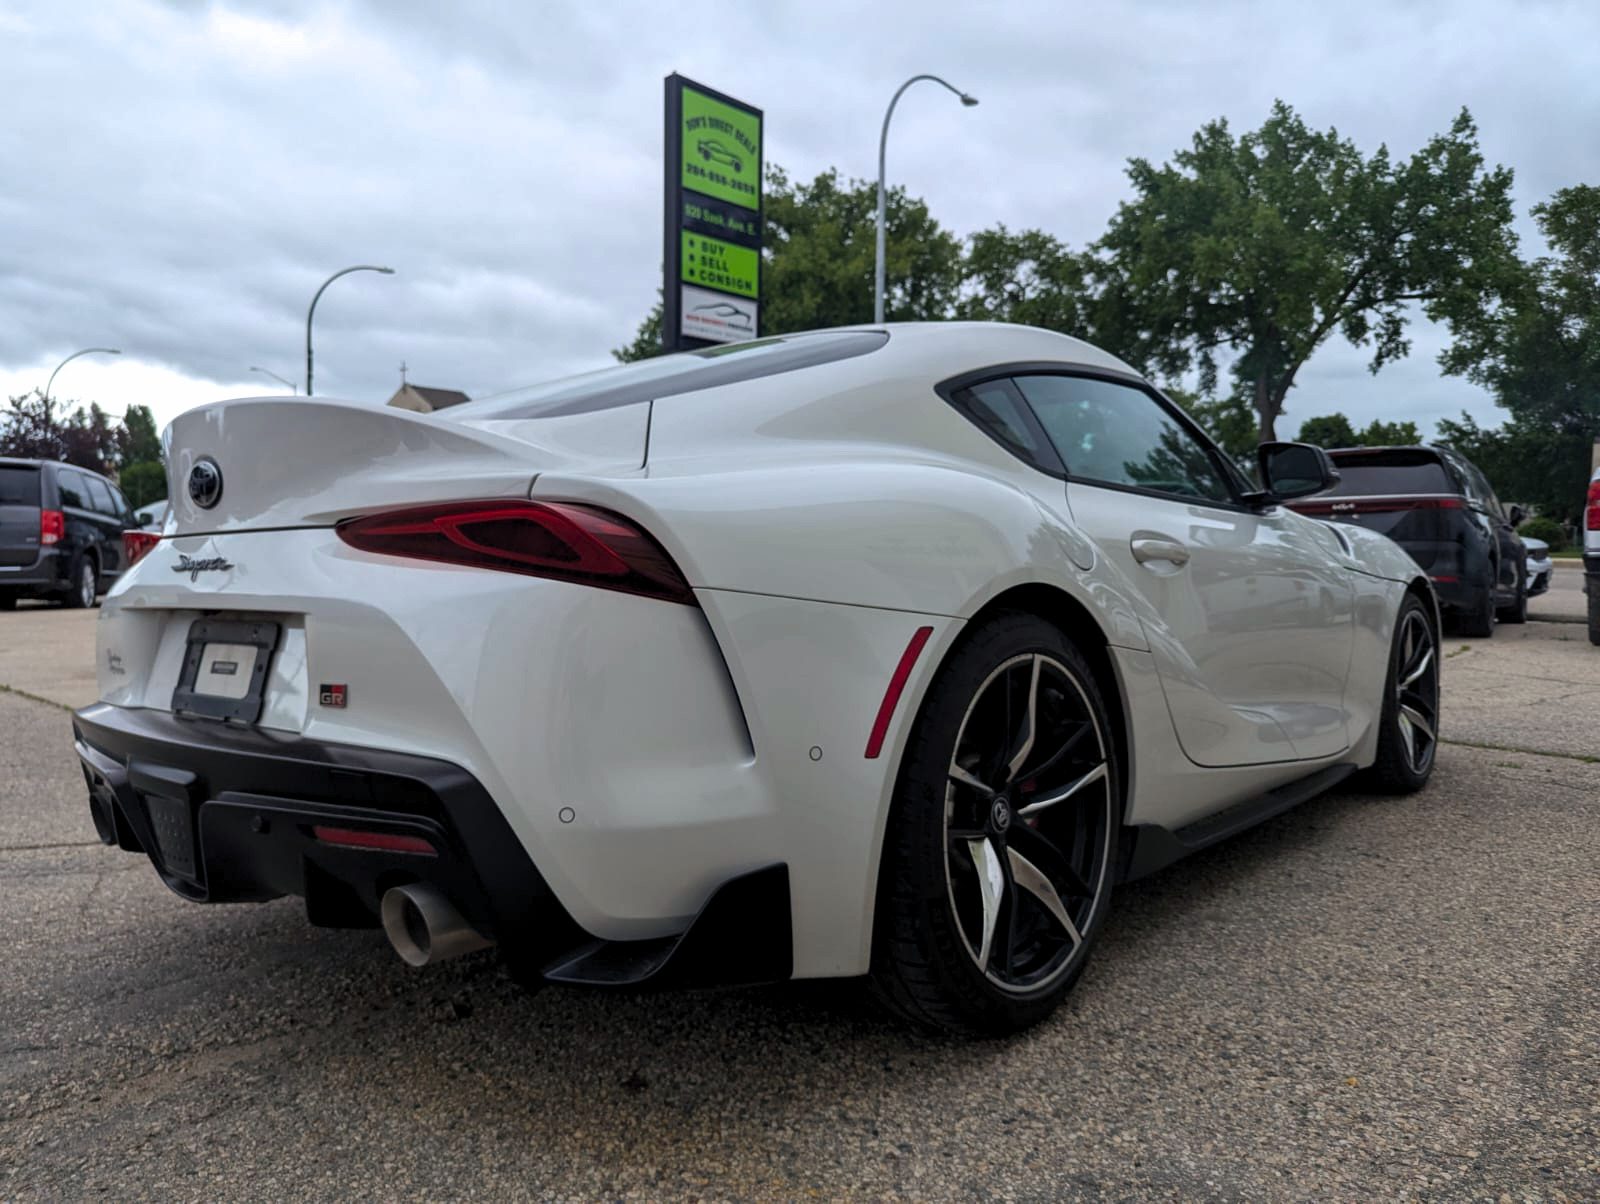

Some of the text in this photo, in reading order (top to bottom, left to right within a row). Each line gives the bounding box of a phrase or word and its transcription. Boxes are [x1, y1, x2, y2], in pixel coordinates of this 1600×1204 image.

[702, 241, 725, 256] BUY
[701, 255, 728, 272] SELL
[700, 269, 752, 291] CONSIGN
[171, 554, 234, 583] Supra
[321, 692, 344, 705] GR
